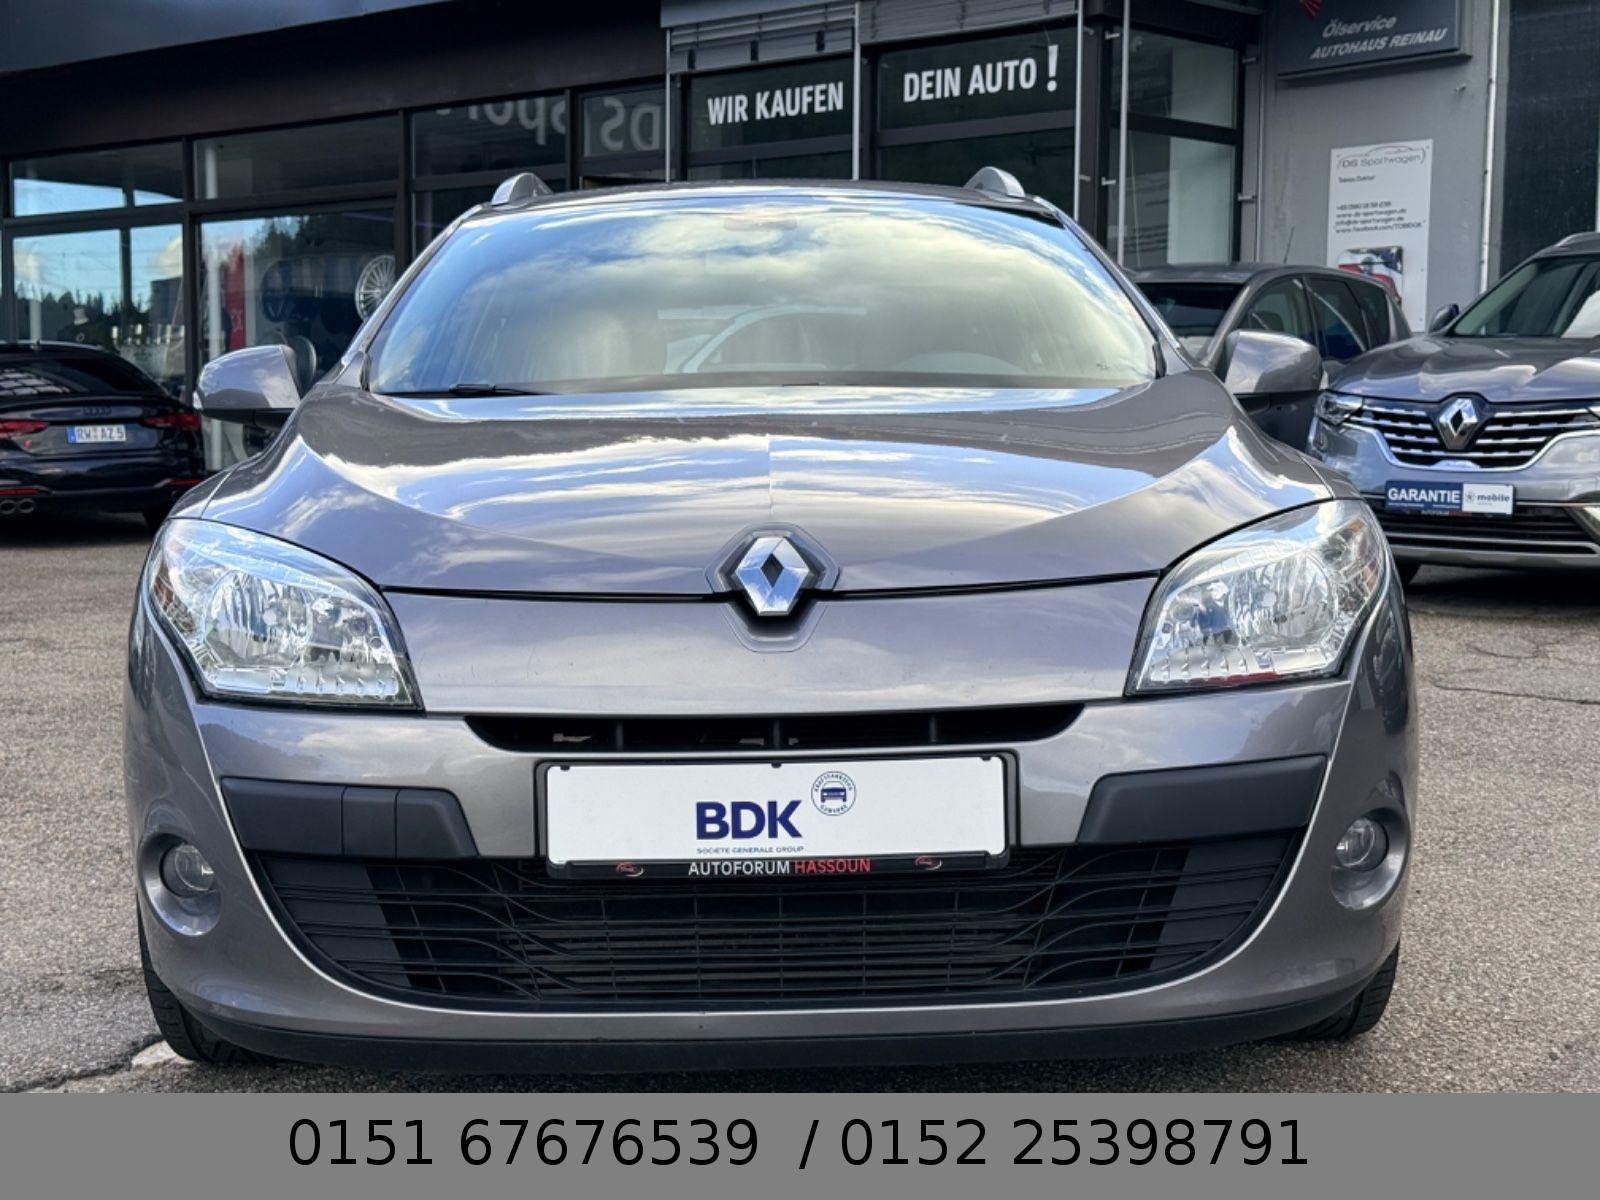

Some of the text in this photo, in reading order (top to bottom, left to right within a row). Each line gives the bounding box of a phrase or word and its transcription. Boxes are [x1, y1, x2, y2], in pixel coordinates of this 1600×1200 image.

[1322, 16, 1397, 38] Ölservice
[1310, 28, 1448, 59] AUTOHAUS REINAU
[707, 95, 749, 125] WIR
[755, 82, 844, 121] KAUFEN
[903, 69, 962, 103] DEIN
[967, 58, 1037, 95] AUTO
[1388, 487, 1510, 503] GARANTIE mobile
[696, 800, 803, 840] BDK
[776, 845, 804, 853] GROUP
[688, 859, 871, 876] AUTOFORUM HASSOUN
